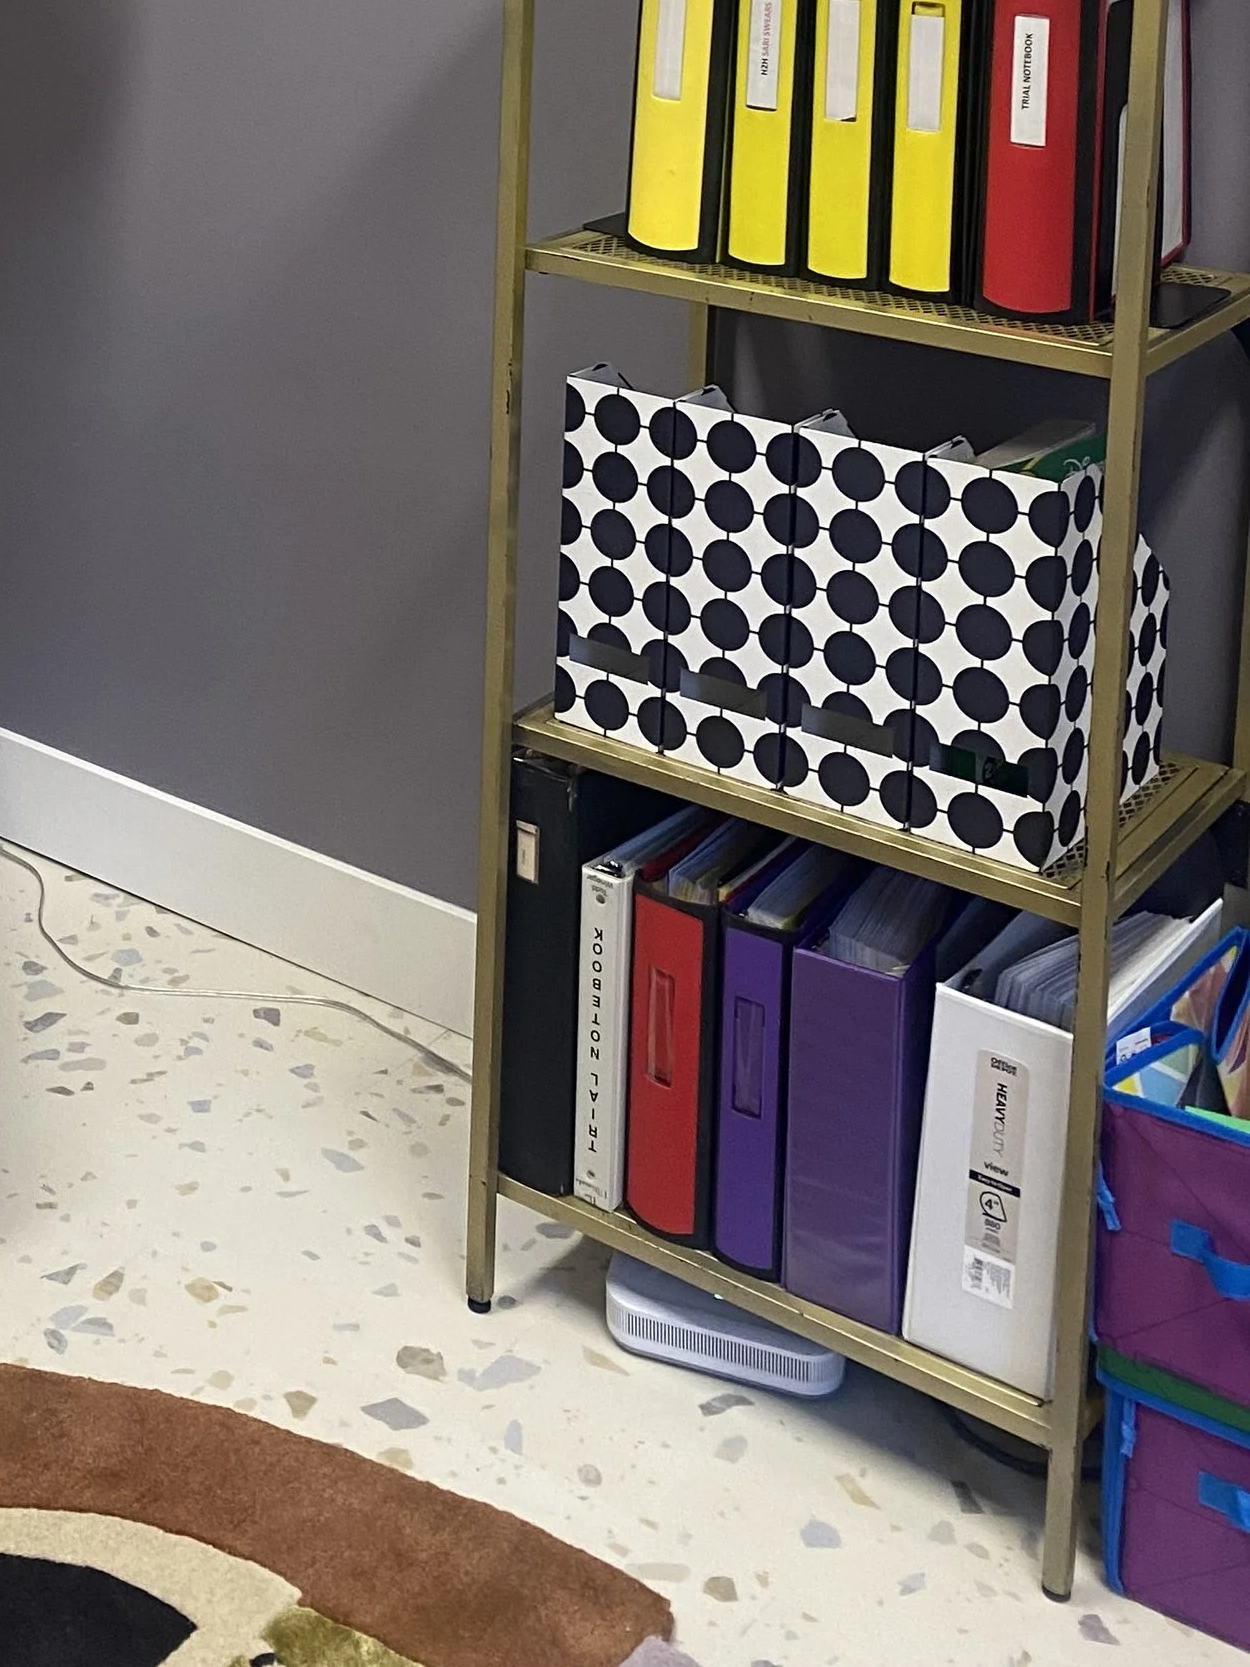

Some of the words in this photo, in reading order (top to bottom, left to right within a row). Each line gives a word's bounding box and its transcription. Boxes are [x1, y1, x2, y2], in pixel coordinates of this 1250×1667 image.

[760, 58, 769, 76] H2H
[1023, 33, 1034, 83] NOTEBOOK
[1021, 85, 1031, 110] TRIAL
[590, 927, 604, 1060] NOTEBOOK
[588, 1072, 599, 1152] TRIAL
